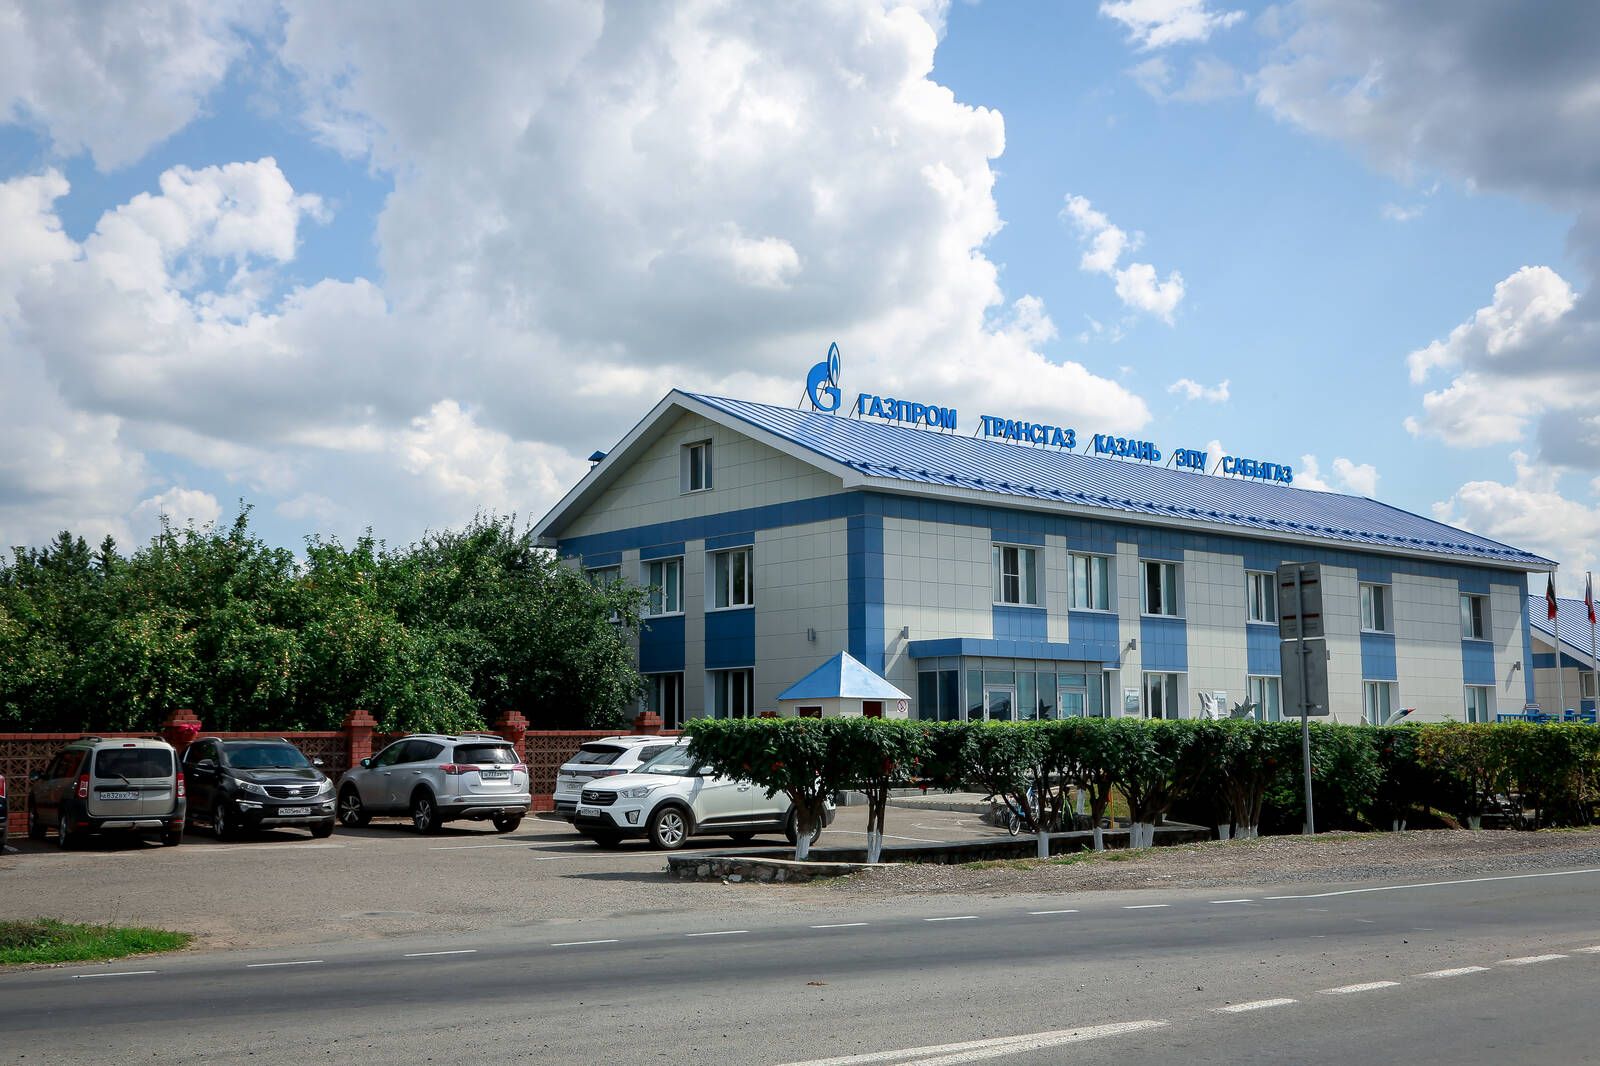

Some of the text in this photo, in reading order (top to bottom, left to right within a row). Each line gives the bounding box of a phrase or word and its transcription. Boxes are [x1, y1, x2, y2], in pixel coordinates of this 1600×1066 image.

[858, 393, 1293, 483] ГАЗПРОМ ТРАНСГАЗ КАЗАНЬ ЭПУ САБЫГАЗ
